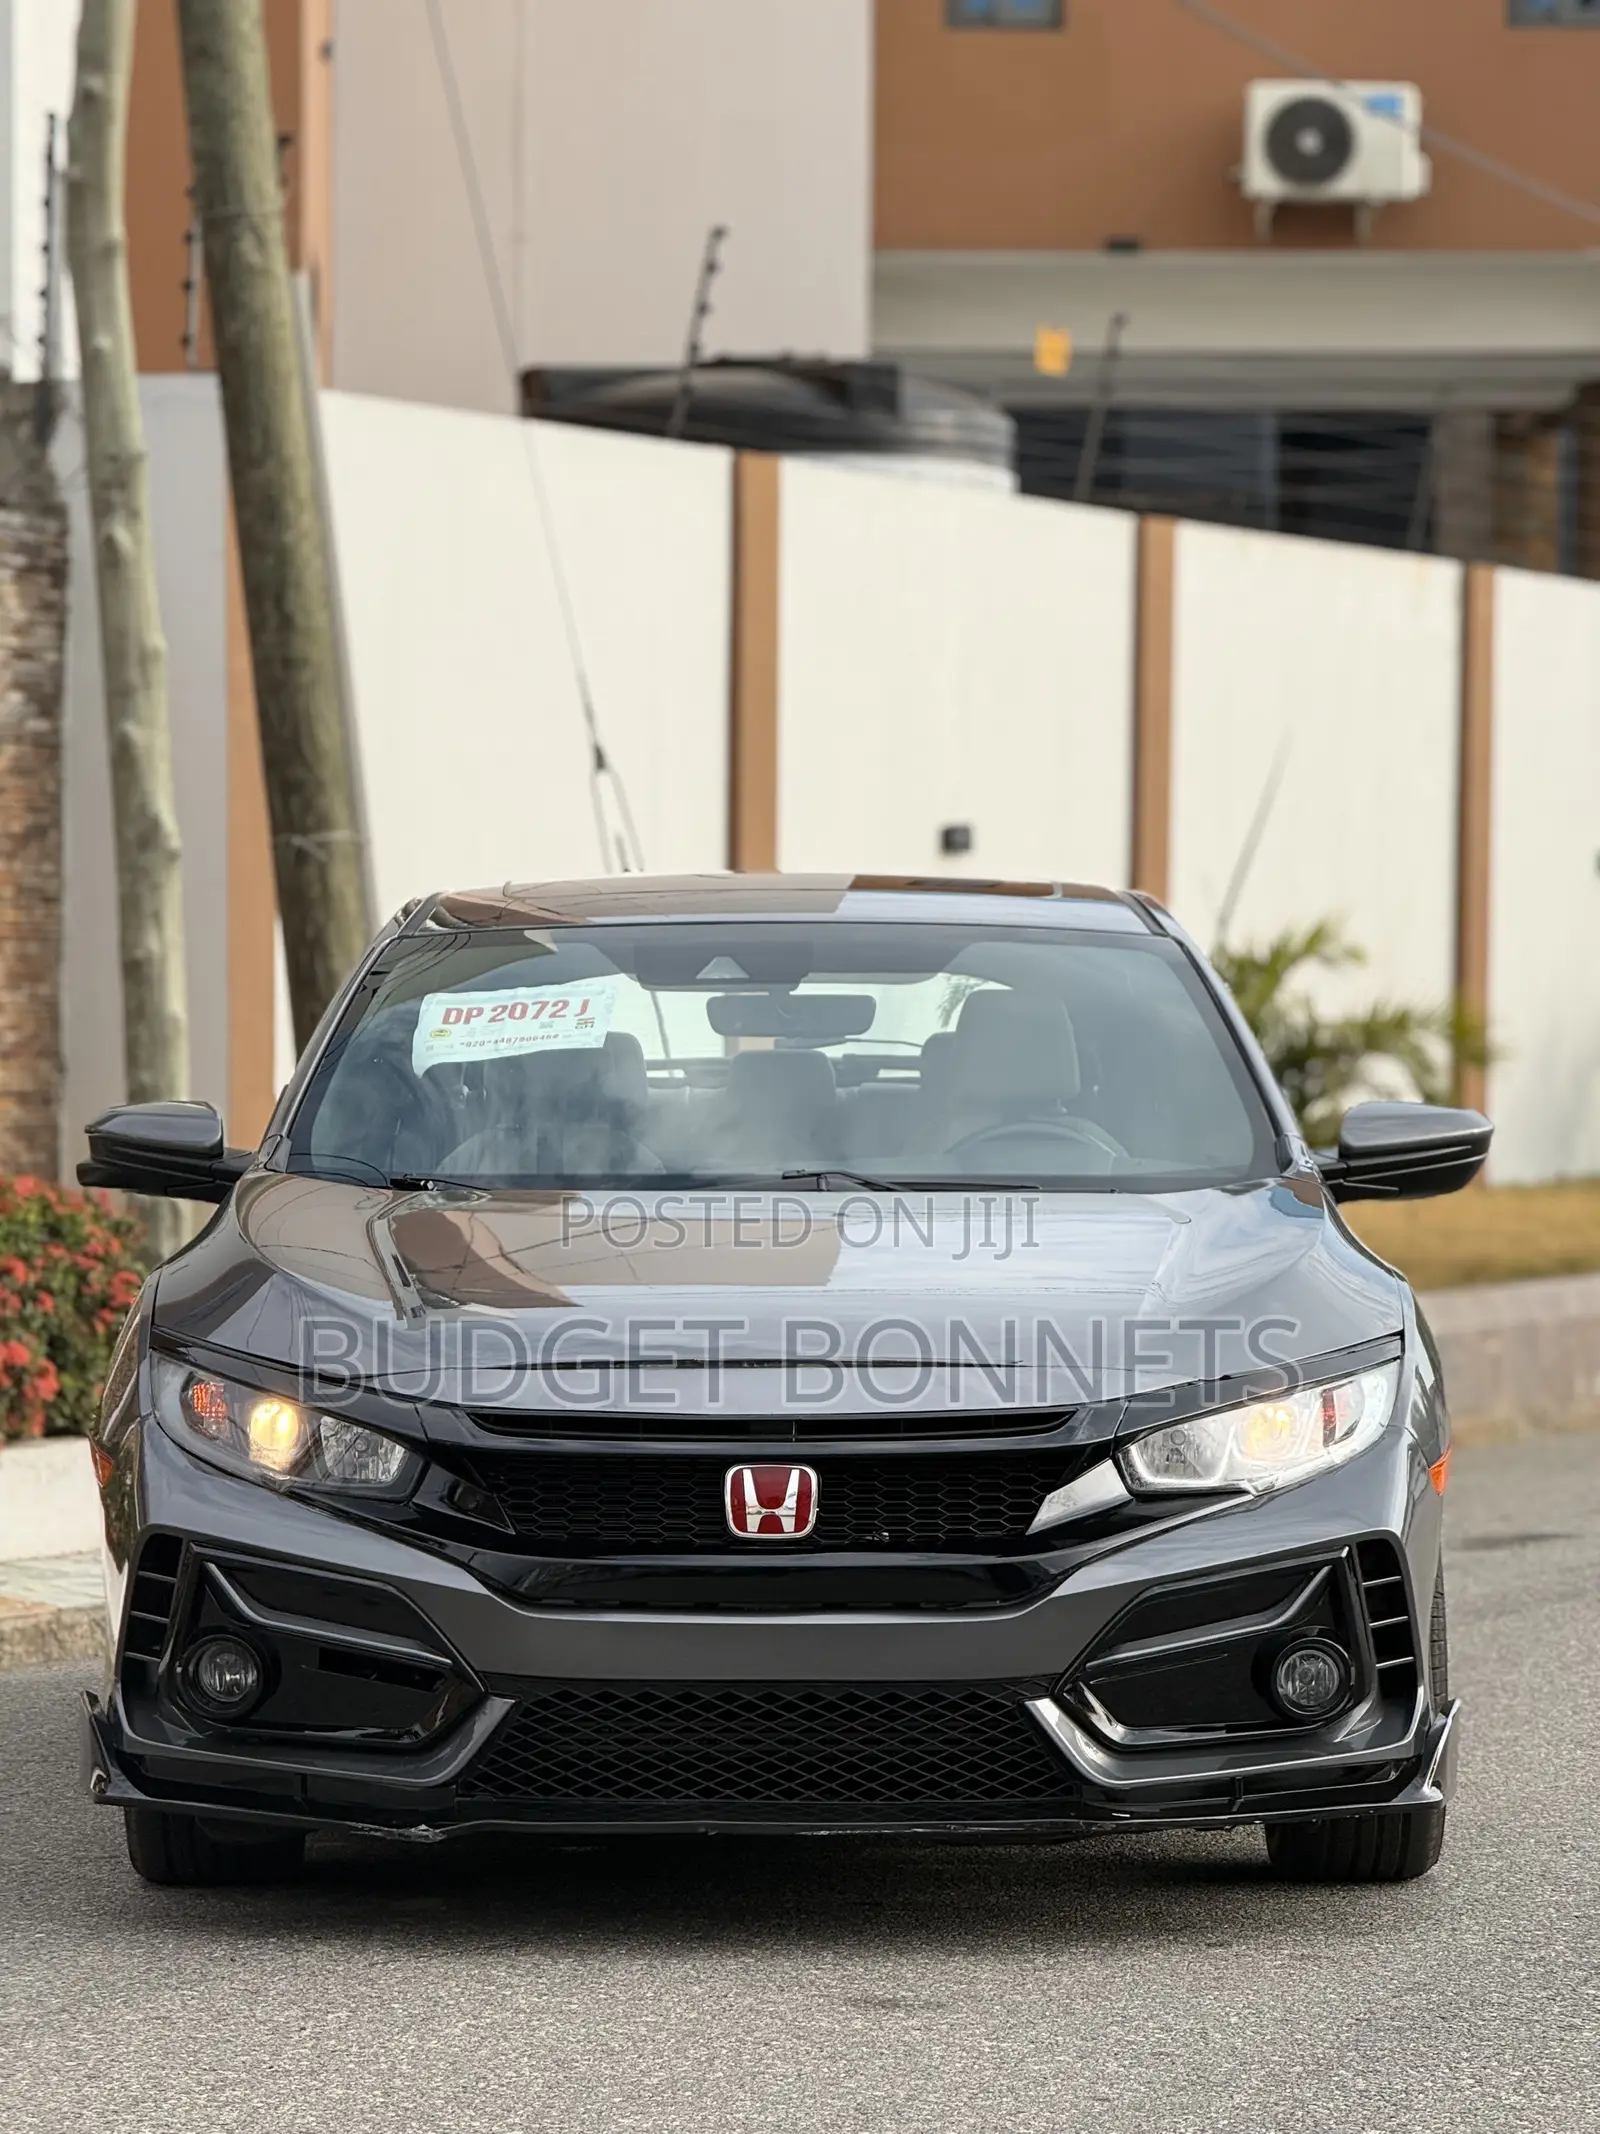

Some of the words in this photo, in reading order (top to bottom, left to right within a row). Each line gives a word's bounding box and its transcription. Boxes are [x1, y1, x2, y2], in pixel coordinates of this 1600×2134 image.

[441, 1007, 484, 1025] DP
[488, 1000, 570, 1023] 2072
[574, 999, 591, 1017] J
